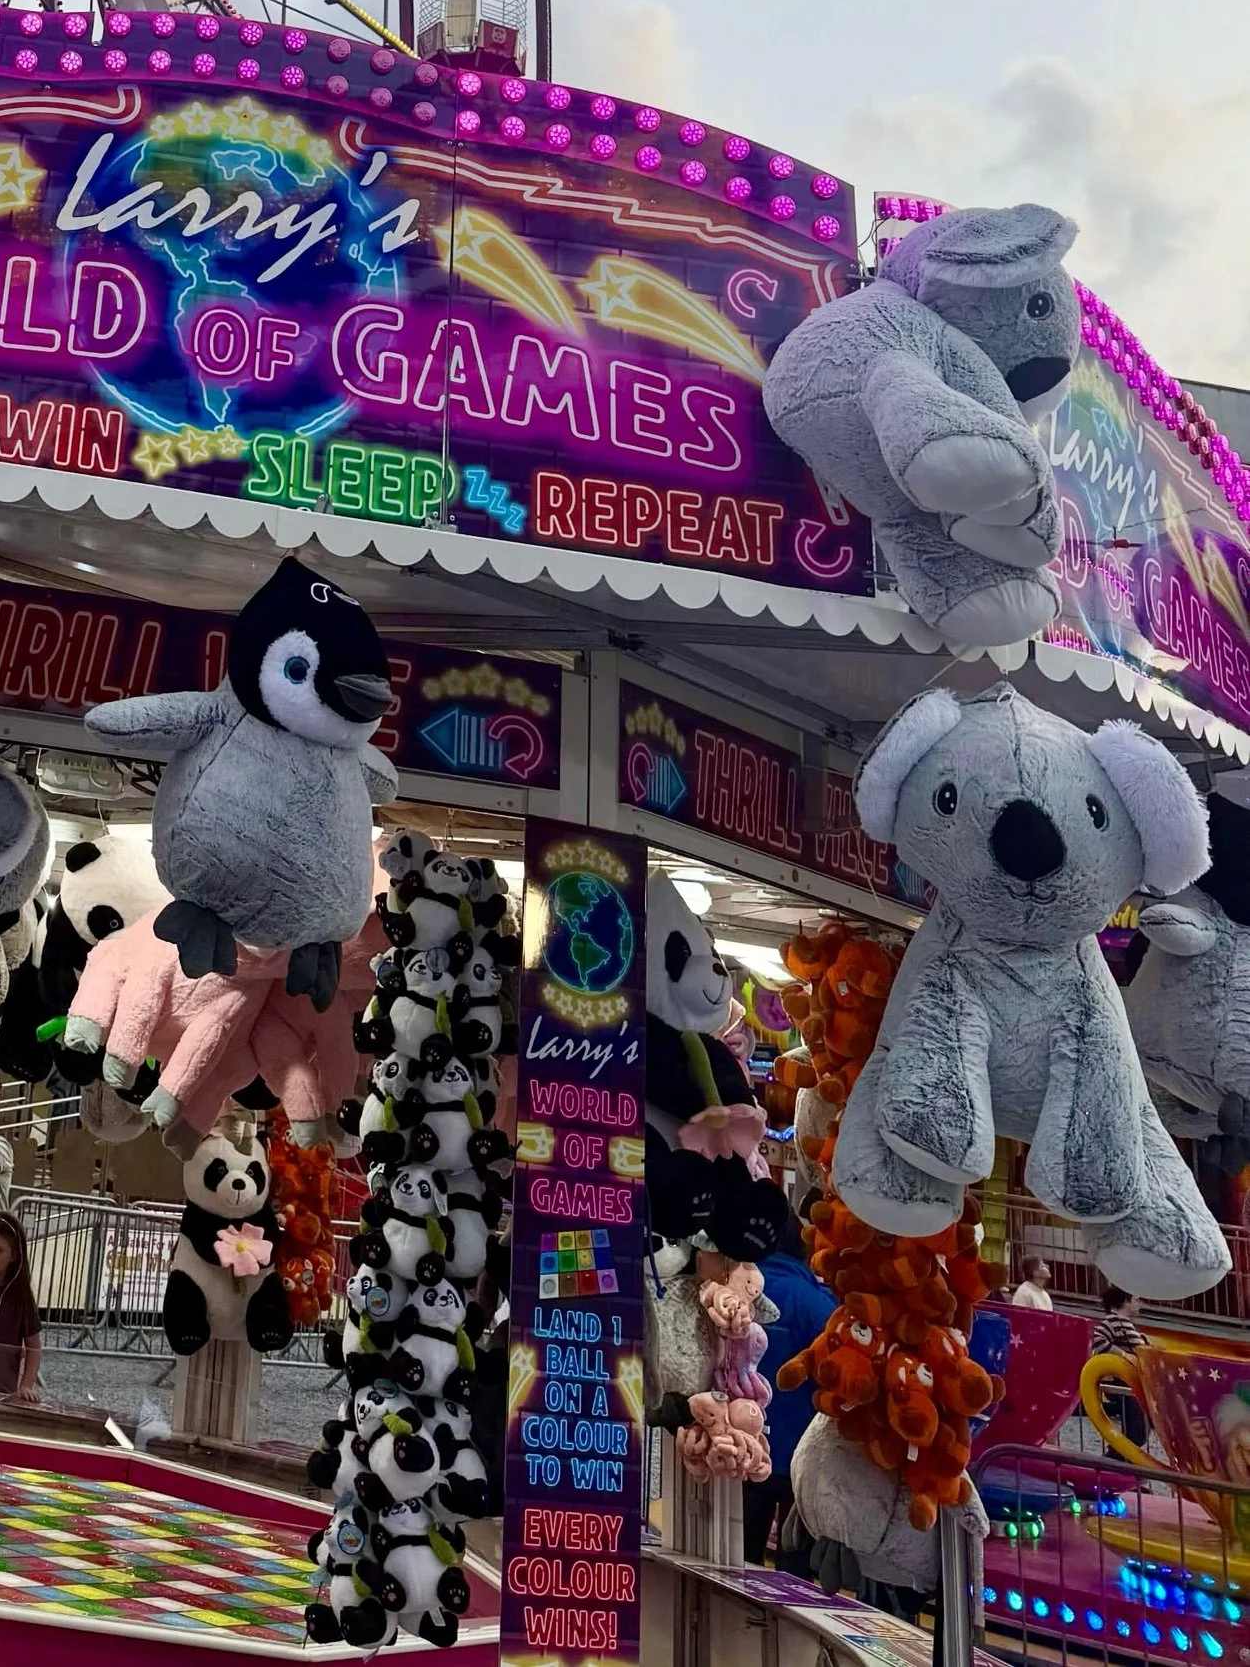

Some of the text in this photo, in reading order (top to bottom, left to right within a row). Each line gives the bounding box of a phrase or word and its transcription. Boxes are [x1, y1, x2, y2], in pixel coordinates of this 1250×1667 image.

[56, 131, 421, 284] Larry's
[193, 308, 300, 382] OF
[331, 302, 742, 473] GAMES
[246, 433, 456, 521] SLEEP
[535, 470, 784, 566] REPEAT
[694, 729, 803, 855] THRILL
[525, 1015, 639, 1080] Larry's
[530, 1079, 638, 1127] WORLD
[563, 1133, 604, 1170] OF
[530, 1178, 634, 1224] GAMES
[533, 1307, 622, 1346] LAND 1
[546, 1344, 610, 1381] BALL
[544, 1381, 609, 1417] ON A
[522, 1417, 628, 1456] COLOUR
[525, 1453, 624, 1493] TO WIN
[524, 1509, 623, 1552] EVERY
[507, 1556, 636, 1602] COLOUR
[524, 1606, 619, 1651] WINS!
